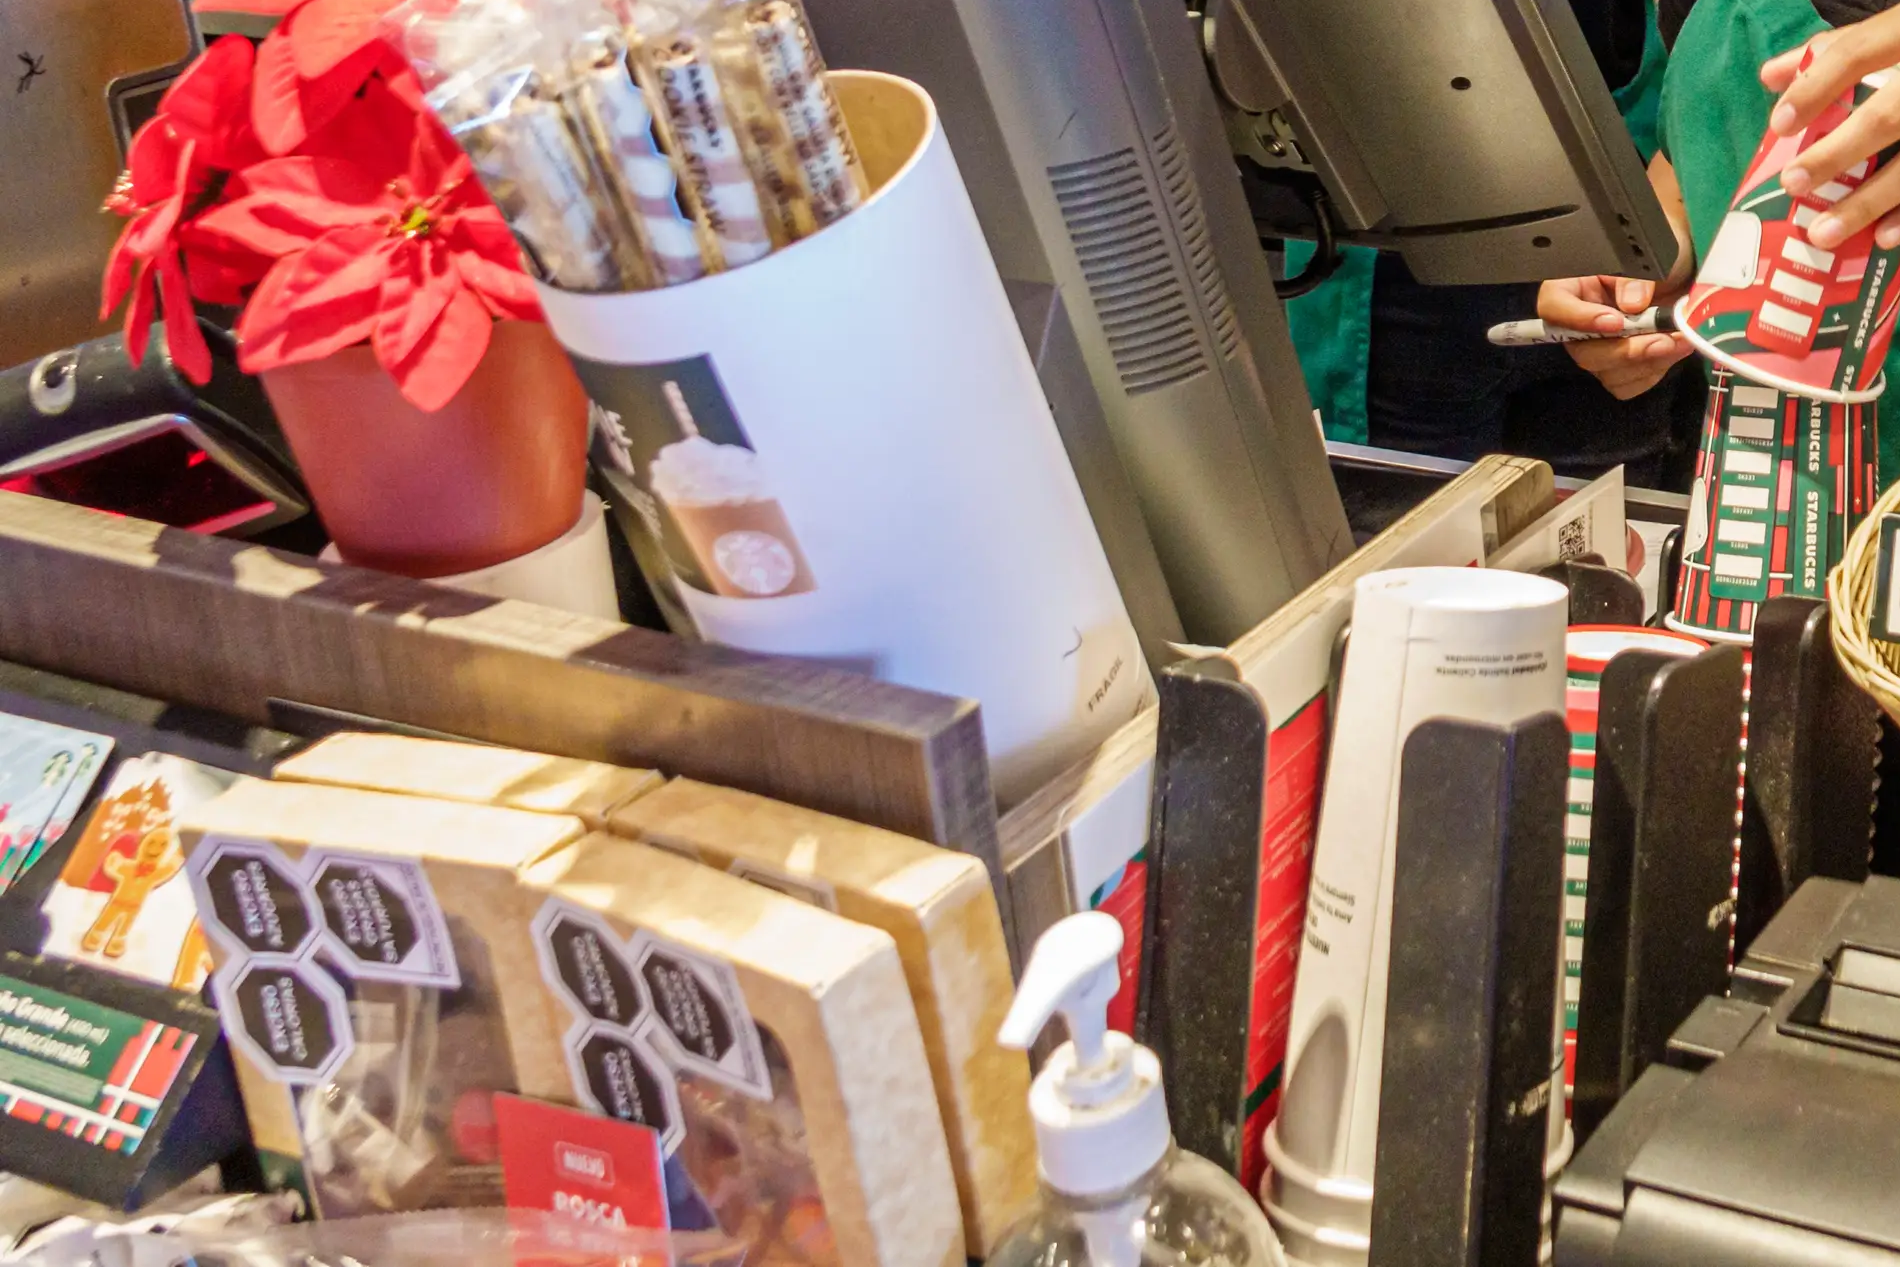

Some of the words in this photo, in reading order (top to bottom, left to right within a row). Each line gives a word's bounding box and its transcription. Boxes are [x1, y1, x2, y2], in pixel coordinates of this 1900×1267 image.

[1855, 258, 1887, 349] STARBUCKS
[1804, 491, 1819, 592] STARBUCKS
[231, 869, 264, 937] EXCESO
[329, 878, 362, 945] EXCESO
[347, 880, 378, 948] GRASAS
[260, 985, 290, 1054] EXCESO
